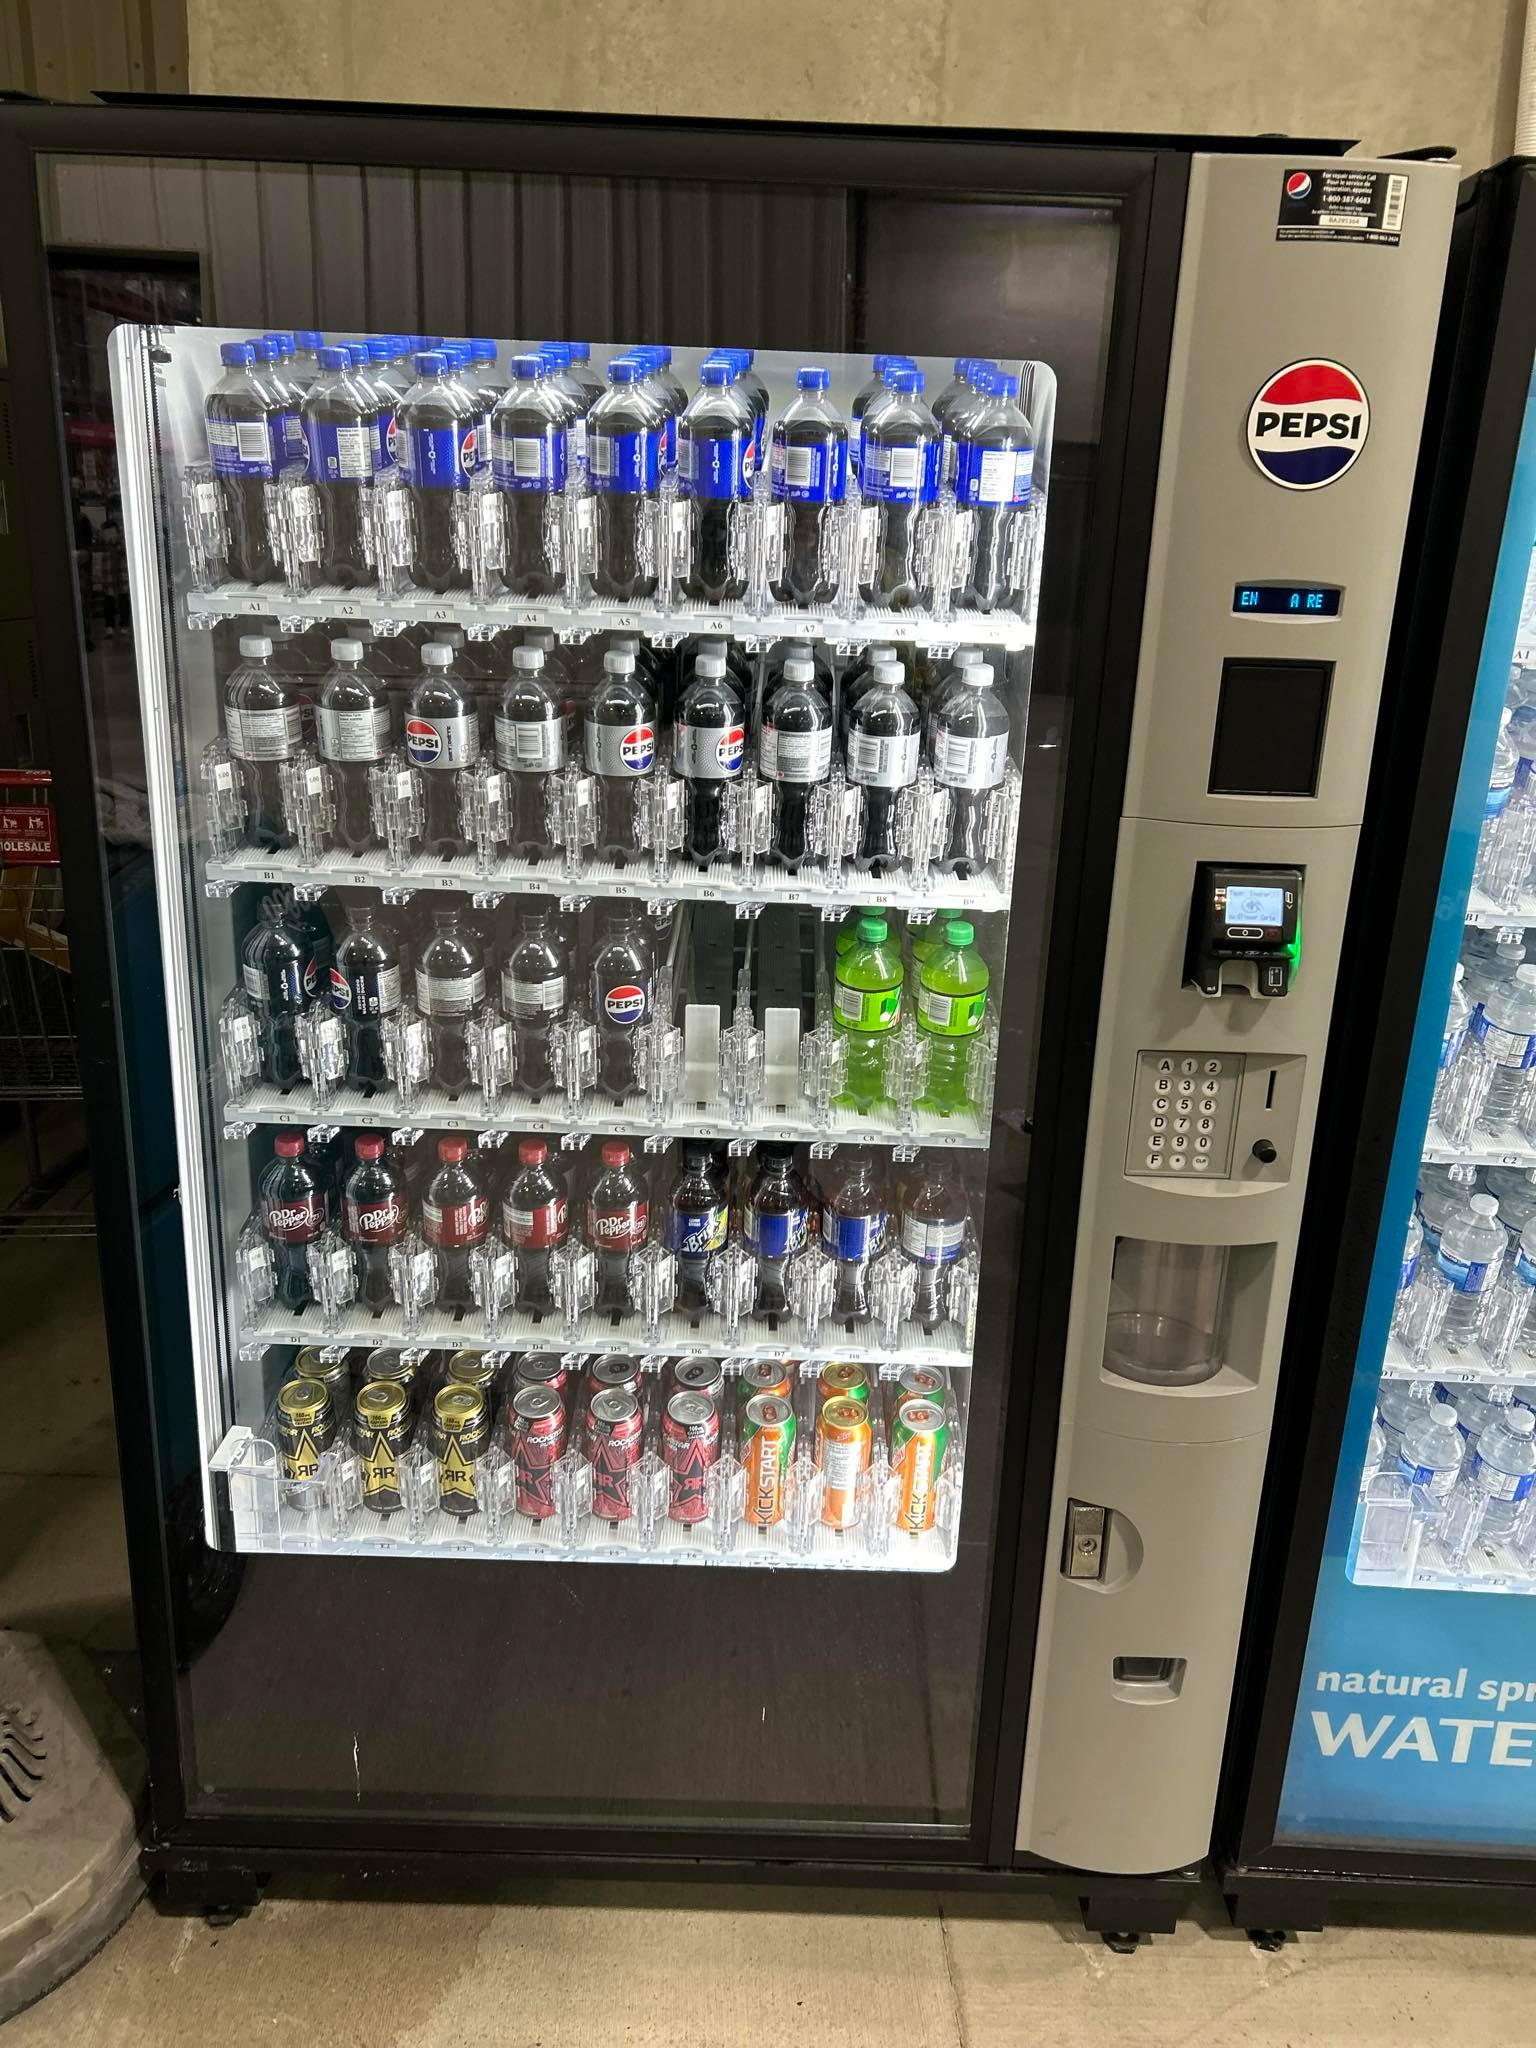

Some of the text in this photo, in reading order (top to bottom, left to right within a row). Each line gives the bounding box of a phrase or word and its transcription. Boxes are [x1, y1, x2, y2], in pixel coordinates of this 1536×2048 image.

[1255, 411, 1361, 439] PEPSI
[1241, 591, 1324, 608] EN A RE
[248, 602, 261, 612] A1
[341, 606, 354, 615] A2
[433, 609, 447, 619] A3
[524, 613, 537, 622] A4
[617, 617, 631, 627] A5
[710, 620, 723, 630] A6
[802, 624, 815, 633] A7
[893, 627, 907, 636] A8
[407, 733, 439, 749] PEPSI
[264, 871, 275, 880] B1
[354, 875, 366, 884] B2
[441, 878, 453, 887] B3
[529, 882, 541, 891] B4
[615, 886, 627, 895] B5
[703, 889, 715, 898] B6
[788, 893, 800, 901] B7
[875, 895, 888, 904] B8
[607, 998, 643, 1010] PEPSI
[1161, 1060, 1217, 1072] A 1 2
[1159, 1080, 1214, 1091] B 3 4
[1156, 1098, 1212, 1110] C 5 6
[279, 1114, 291, 1122] C1
[361, 1117, 373, 1125] C2
[447, 1119, 459, 1127] C3
[532, 1122, 544, 1130] C4
[1154, 1117, 1209, 1129] D 7 8
[614, 1125, 626, 1133] C5
[700, 1128, 711, 1136] C6
[780, 1131, 791, 1139] C7
[863, 1134, 875, 1142] C8
[944, 1136, 956, 1145] C9
[1152, 1136, 1207, 1148] E 9 0
[1151, 1154, 1159, 1164] F
[1502, 1156, 1517, 1165] C2
[290, 1336, 301, 1344] D1
[372, 1338, 383, 1347] D2
[452, 1341, 463, 1349] D3
[532, 1343, 544, 1351] D4
[610, 1345, 622, 1353] D5
[691, 1347, 702, 1356] D6
[774, 1350, 785, 1359] D7
[1461, 1374, 1475, 1382] D2
[758, 1436, 776, 1525] KICKSTART
[1316, 1667, 1536, 1712] natural spr
[1311, 1711, 1536, 1767] WATE
